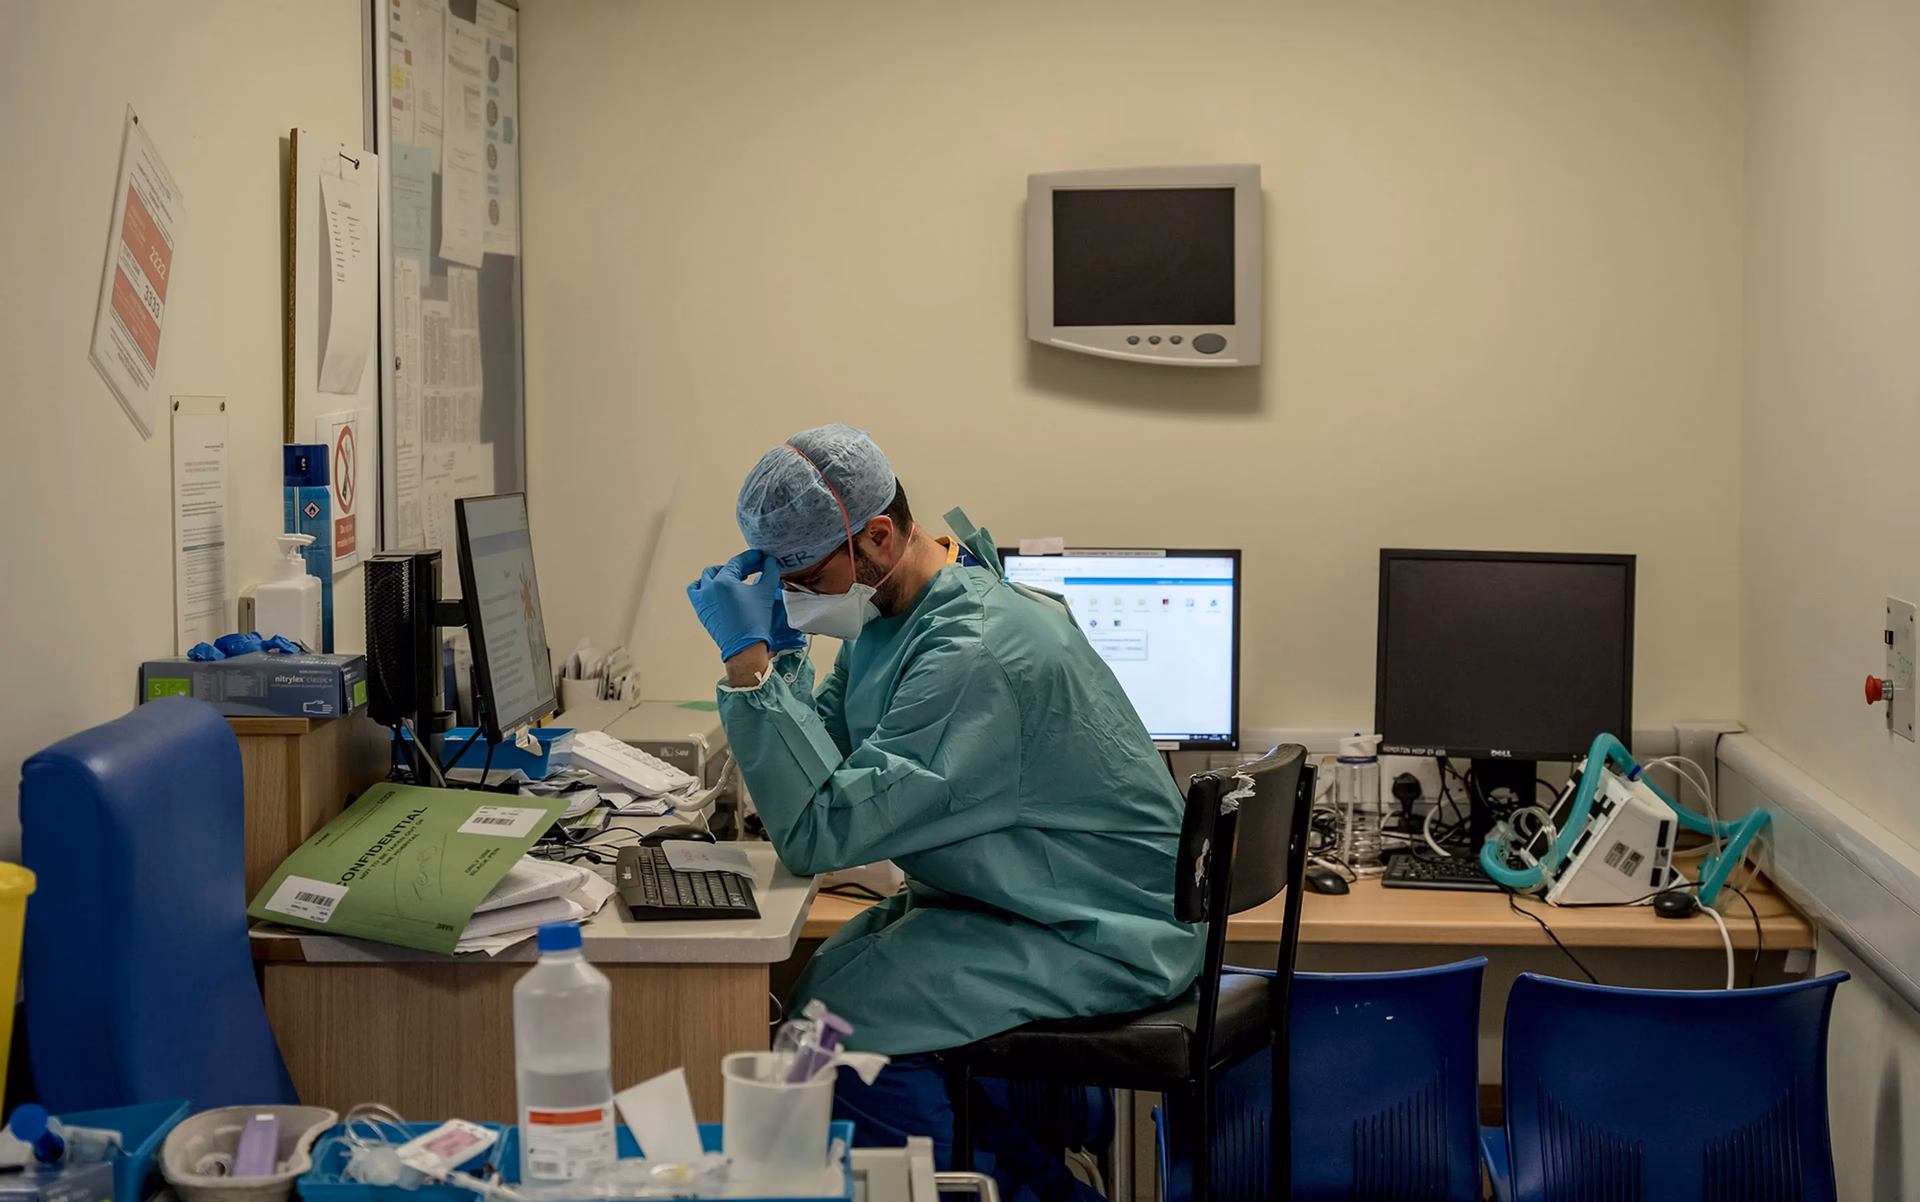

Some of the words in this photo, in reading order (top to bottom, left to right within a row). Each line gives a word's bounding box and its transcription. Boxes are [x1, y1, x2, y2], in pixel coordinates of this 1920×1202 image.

[149, 245, 166, 280] 2222
[143, 285, 160, 319] 3333
[154, 683, 161, 695] S
[275, 675, 304, 684] nitrylex
[1490, 749, 1512, 758] DELL
[336, 806, 428, 887] ONFIDENTIAL
[359, 868, 372, 880] NOT
[370, 860, 380, 868] TO
[387, 836, 405, 852] TAKEN
[393, 833, 420, 856] HOSPITAL
